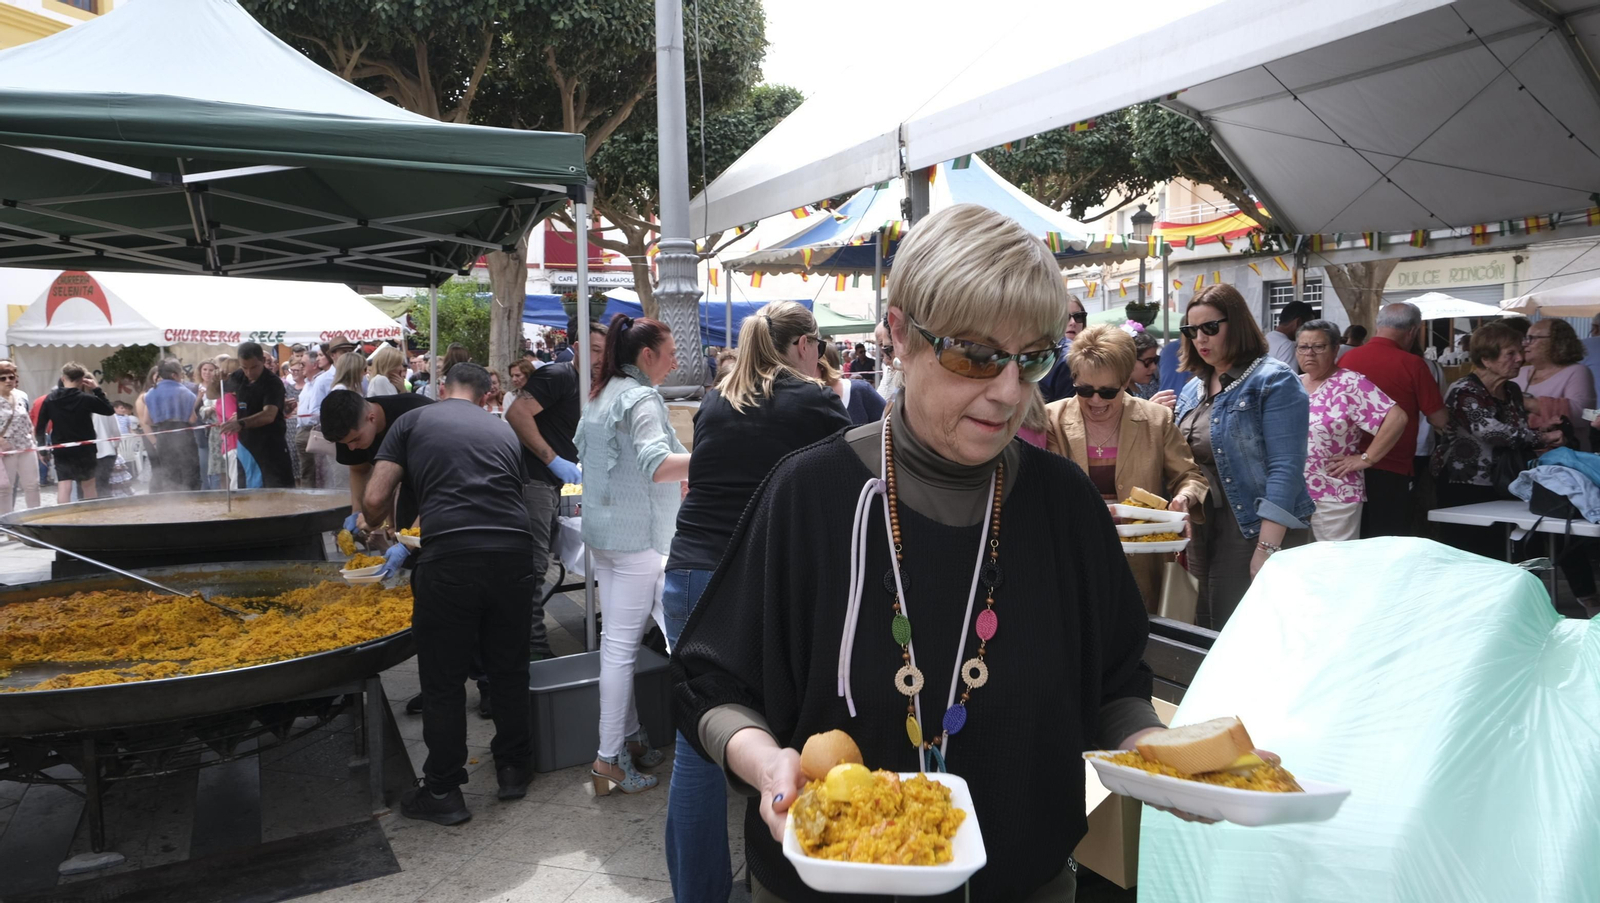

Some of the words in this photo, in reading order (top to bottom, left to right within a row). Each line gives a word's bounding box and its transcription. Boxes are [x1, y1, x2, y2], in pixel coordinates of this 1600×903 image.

[588, 275, 608, 283] ADERÍA
[1398, 269, 1441, 287] DULCE
[1449, 260, 1506, 283] RINCÓN
[52, 285, 94, 297] SELENITA
[164, 328, 241, 343] CHURRERIA
[248, 330, 286, 343] SELE
